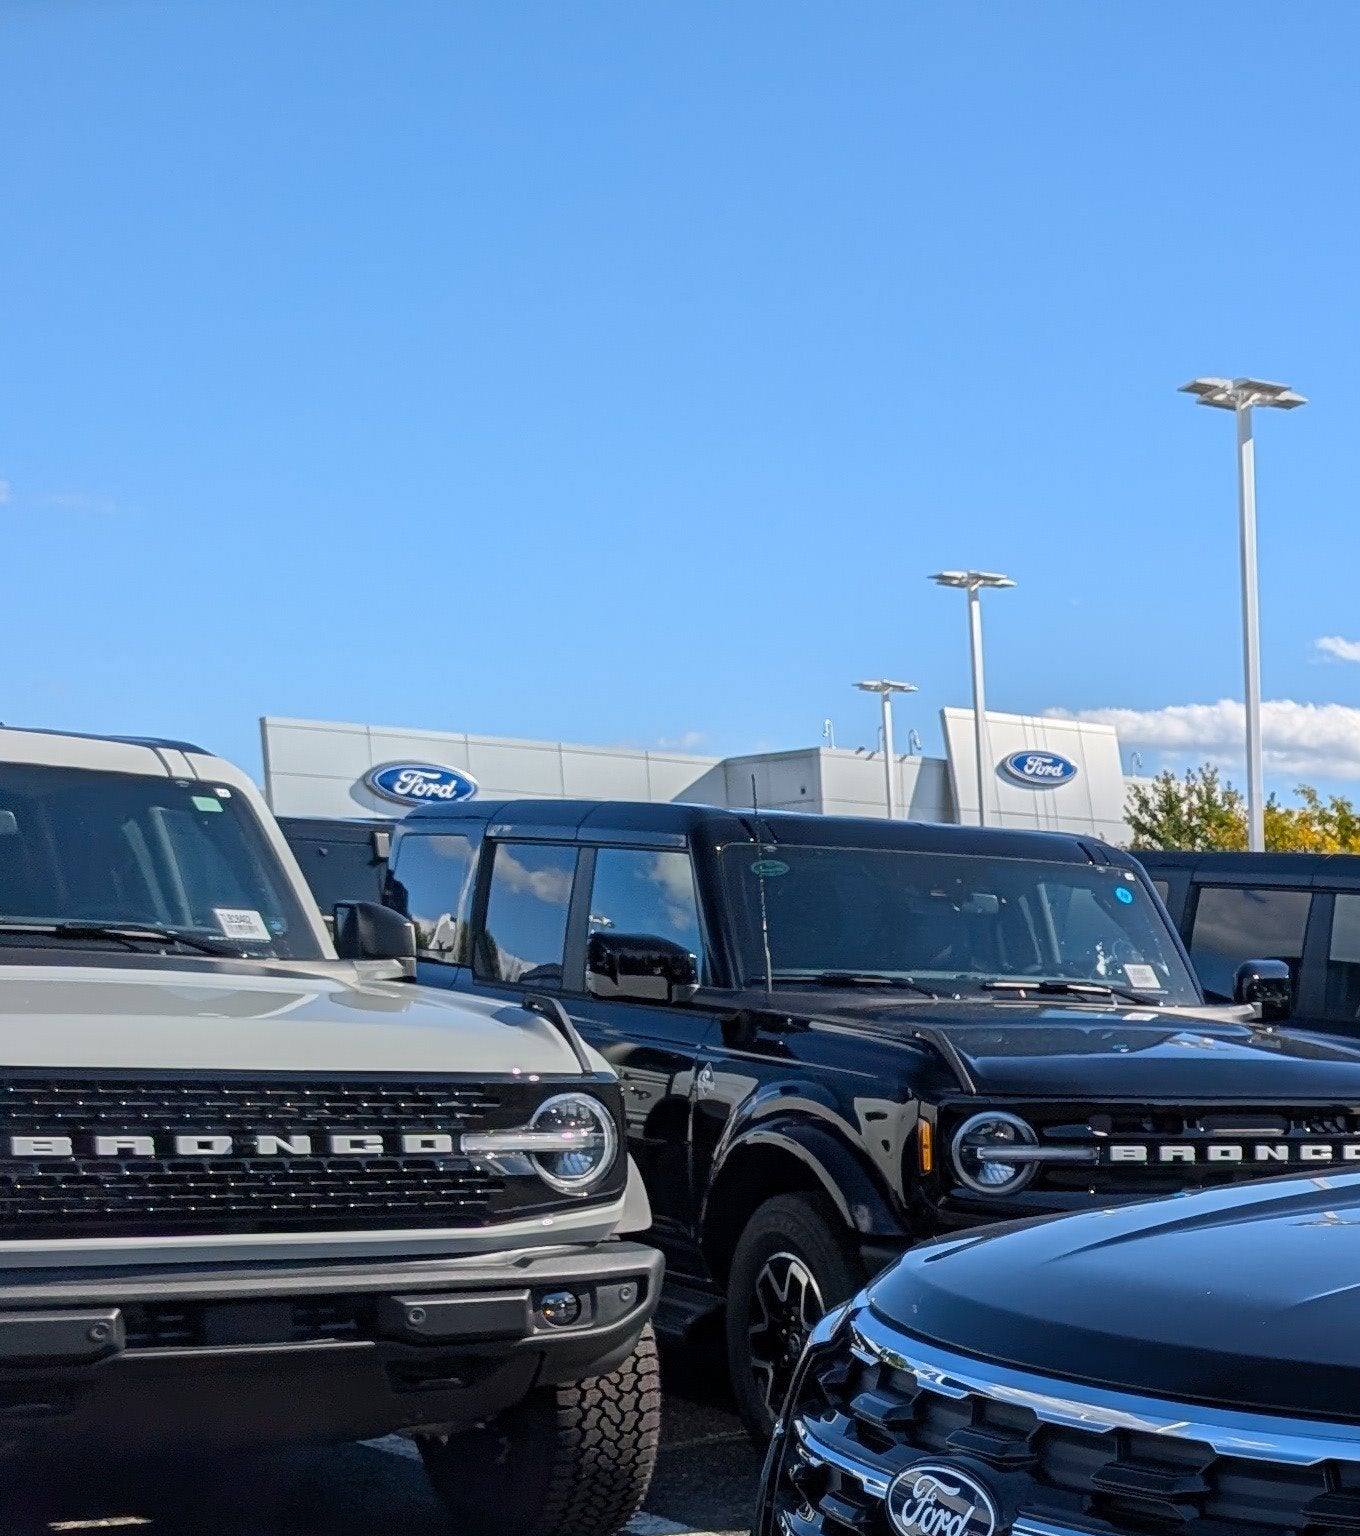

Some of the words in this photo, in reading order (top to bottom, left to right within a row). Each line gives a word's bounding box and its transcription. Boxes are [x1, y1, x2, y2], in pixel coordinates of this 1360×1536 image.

[1024, 755, 1064, 777] Ford
[393, 769, 458, 799] Ford
[10, 1134, 453, 1157] BRONCO
